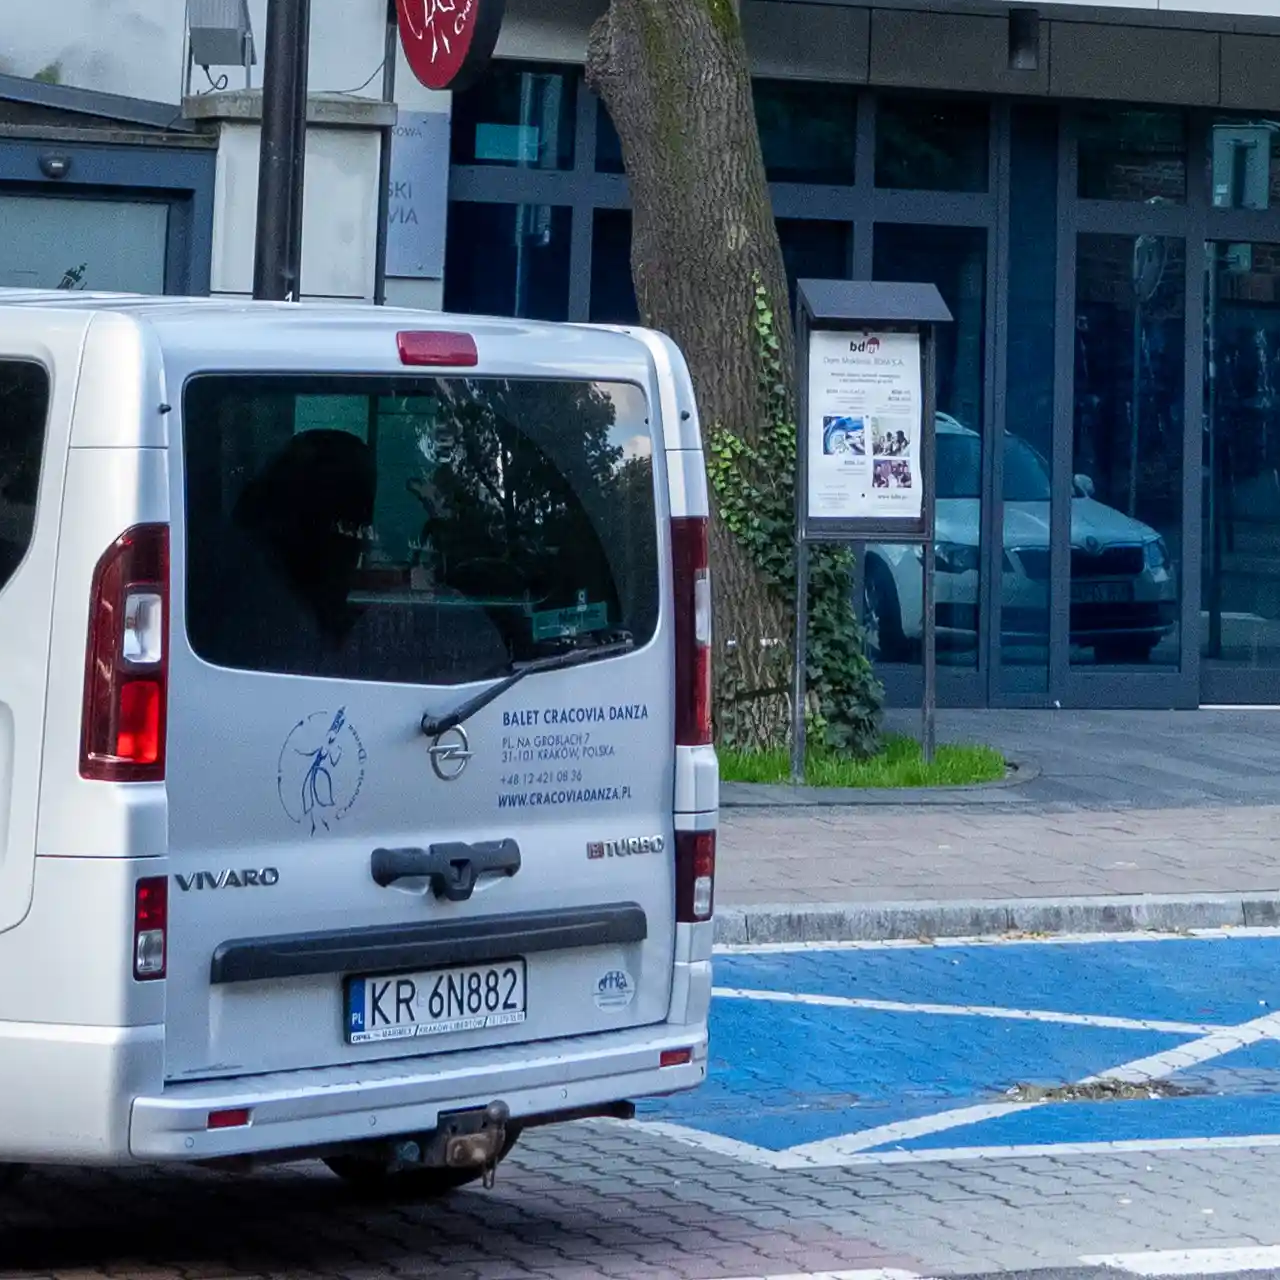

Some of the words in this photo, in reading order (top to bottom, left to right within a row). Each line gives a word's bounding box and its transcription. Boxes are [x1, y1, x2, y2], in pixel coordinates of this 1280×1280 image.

[850, 337, 880, 354] bdm
[502, 710, 539, 727] BALET
[543, 707, 605, 724] CRACOVIA
[609, 704, 648, 721] DANZA
[517, 737, 531, 748] NA
[582, 745, 615, 758] POLSKA
[500, 773, 519, 785] +48
[536, 771, 553, 783] 421
[498, 786, 632, 808] WWW.CRACOVIADANZA.PL
[174, 867, 280, 892] VIVARO
[371, 979, 417, 1026] KR
[428, 967, 518, 1019] 6N882
[352, 1012, 363, 1025] PL
